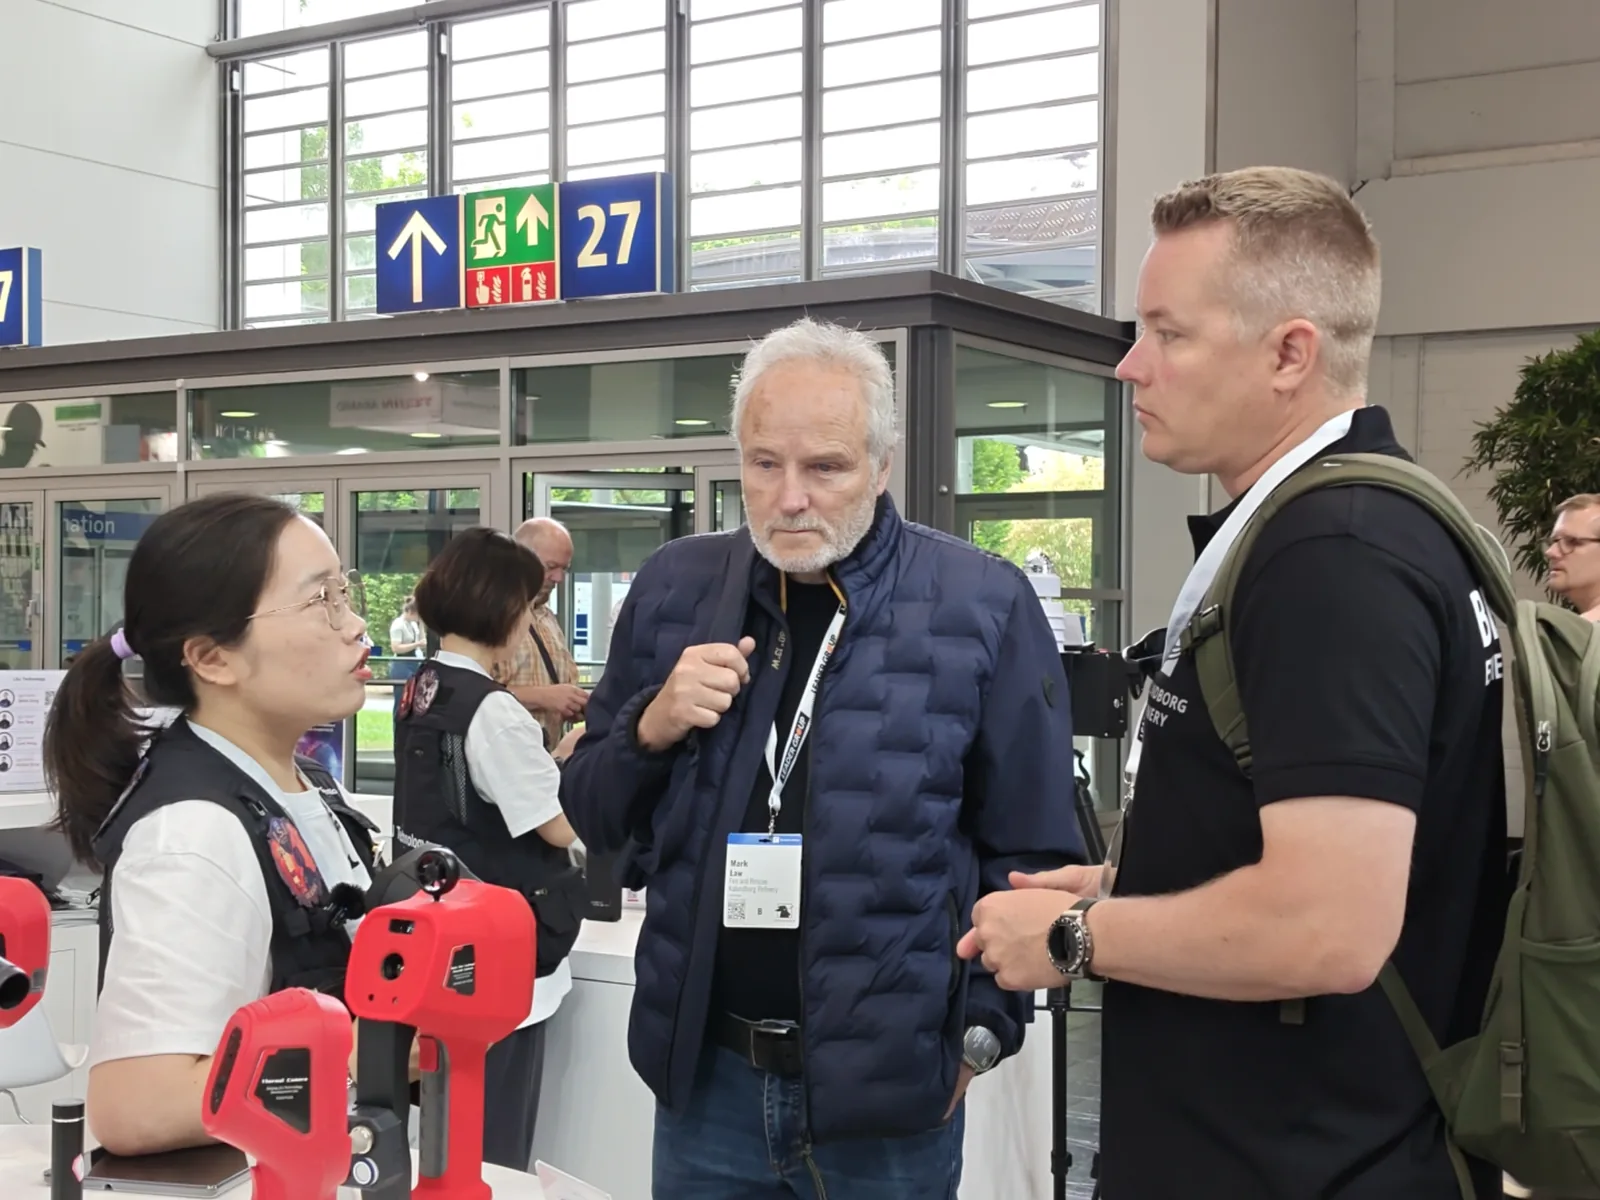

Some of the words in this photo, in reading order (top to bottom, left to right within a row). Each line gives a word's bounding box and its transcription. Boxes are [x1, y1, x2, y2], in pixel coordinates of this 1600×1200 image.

[577, 200, 641, 268] 27
[781, 747, 796, 780] LEADER
[792, 716, 807, 747] GROUP
[729, 869, 743, 877] Law
[730, 859, 749, 868] Mark
